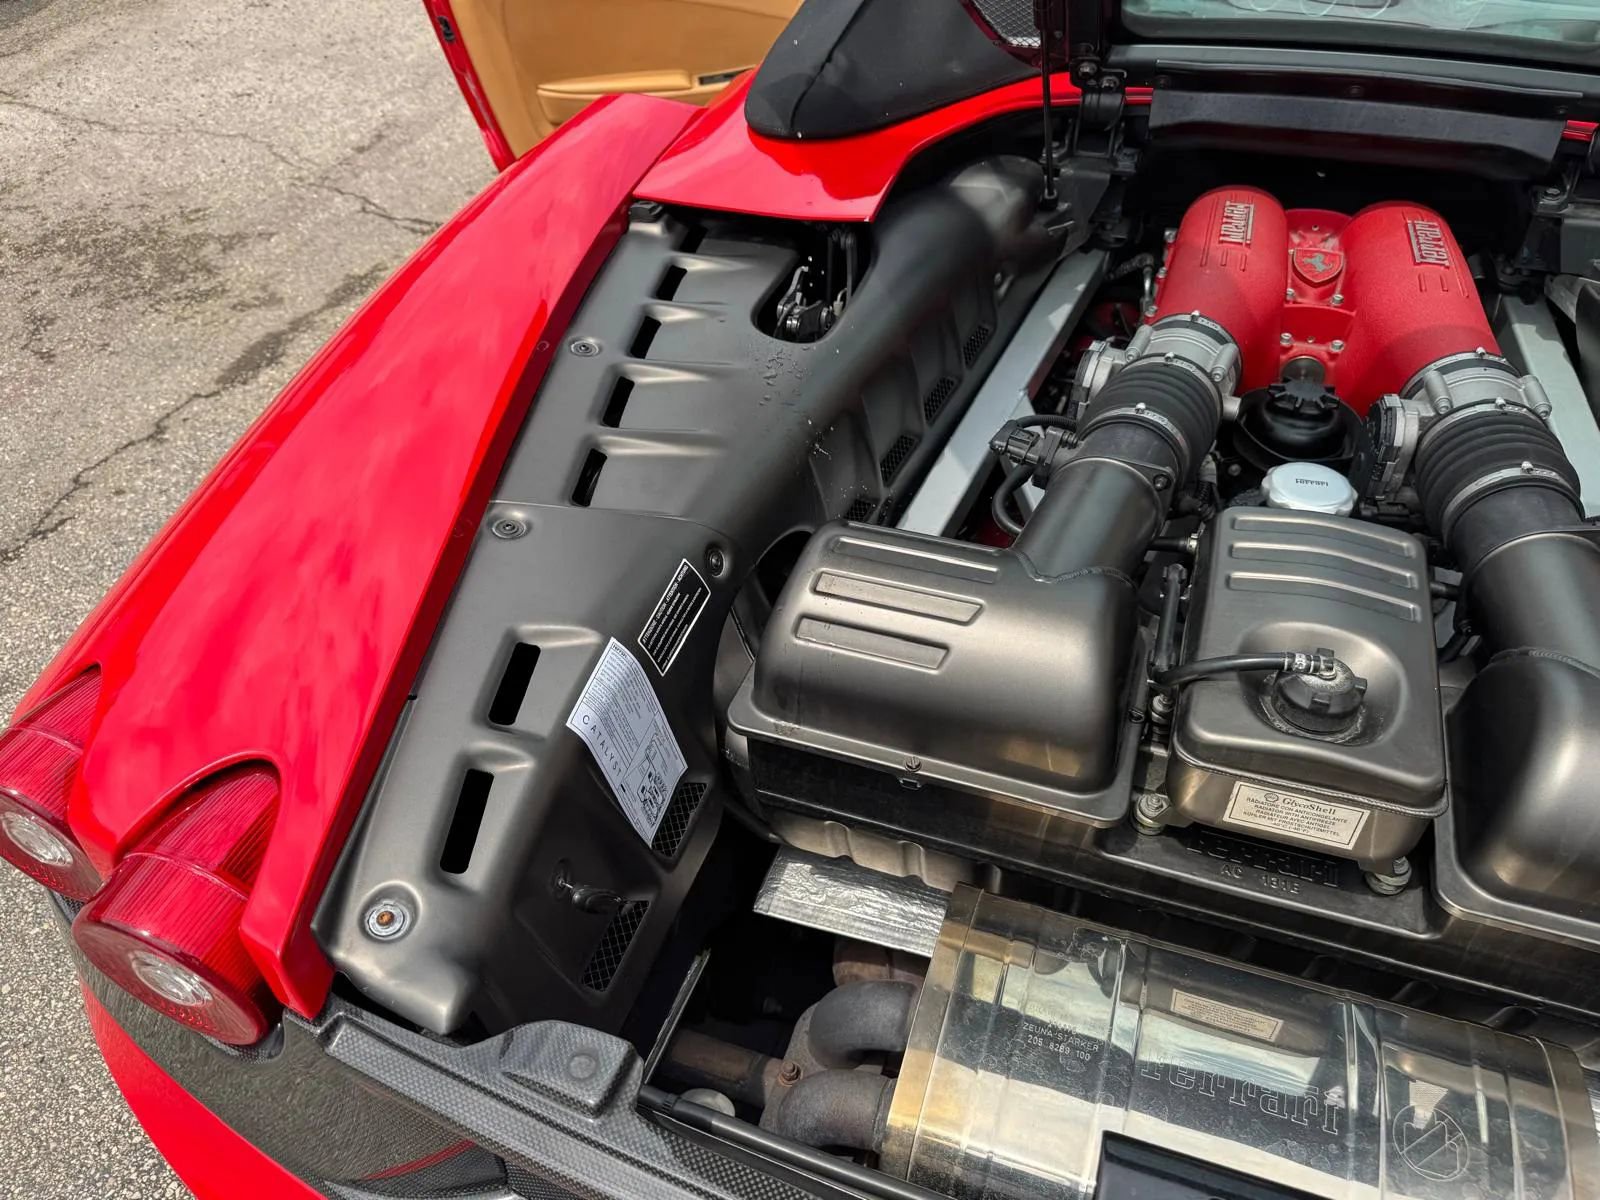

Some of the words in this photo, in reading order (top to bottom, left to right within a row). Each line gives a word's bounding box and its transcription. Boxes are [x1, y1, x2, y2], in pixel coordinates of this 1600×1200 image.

[1219, 200, 1254, 243] Ferrari
[1407, 220, 1449, 266] Ferrari
[582, 714, 621, 776] CATALYST
[1246, 797, 1279, 808] RADIATORE
[1281, 796, 1336, 815] GlycoShell
[1254, 804, 1284, 814] RADIATOR
[1299, 814, 1335, 825] ANTIFREEZE
[1255, 809, 1288, 820] RADIATEUR
[1305, 820, 1330, 829] ANTIGEL
